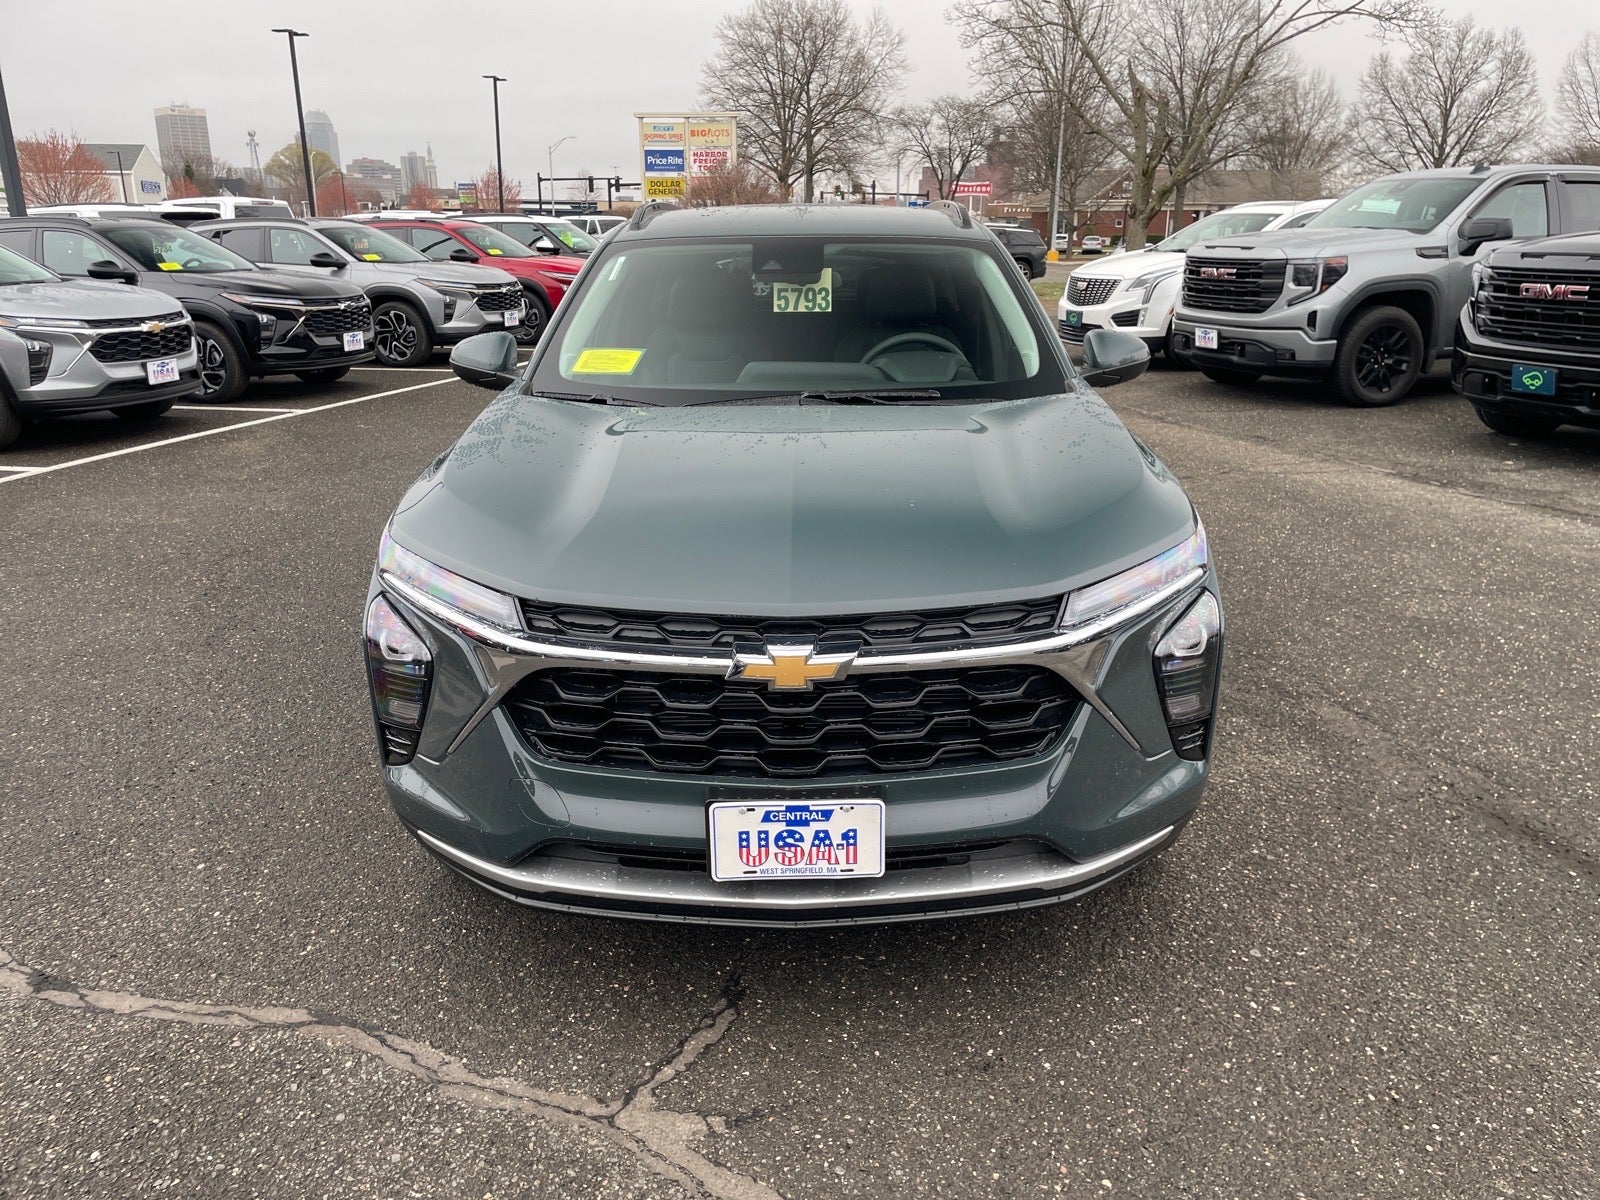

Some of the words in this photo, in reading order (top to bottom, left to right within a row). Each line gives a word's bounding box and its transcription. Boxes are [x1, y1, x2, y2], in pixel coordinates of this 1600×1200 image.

[668, 133, 684, 142] SPREE
[647, 156, 667, 165] Price
[668, 156, 684, 165] Rite
[650, 180, 681, 188] DOLLAR
[648, 188, 684, 196] GENERAL
[1200, 267, 1237, 280] GMC
[1519, 282, 1591, 302] GMC
[776, 286, 831, 311] 5793
[769, 811, 826, 821] CENTRAL
[737, 828, 858, 868] USA-1
[759, 867, 779, 875] WEST
[826, 867, 838, 875] MA
